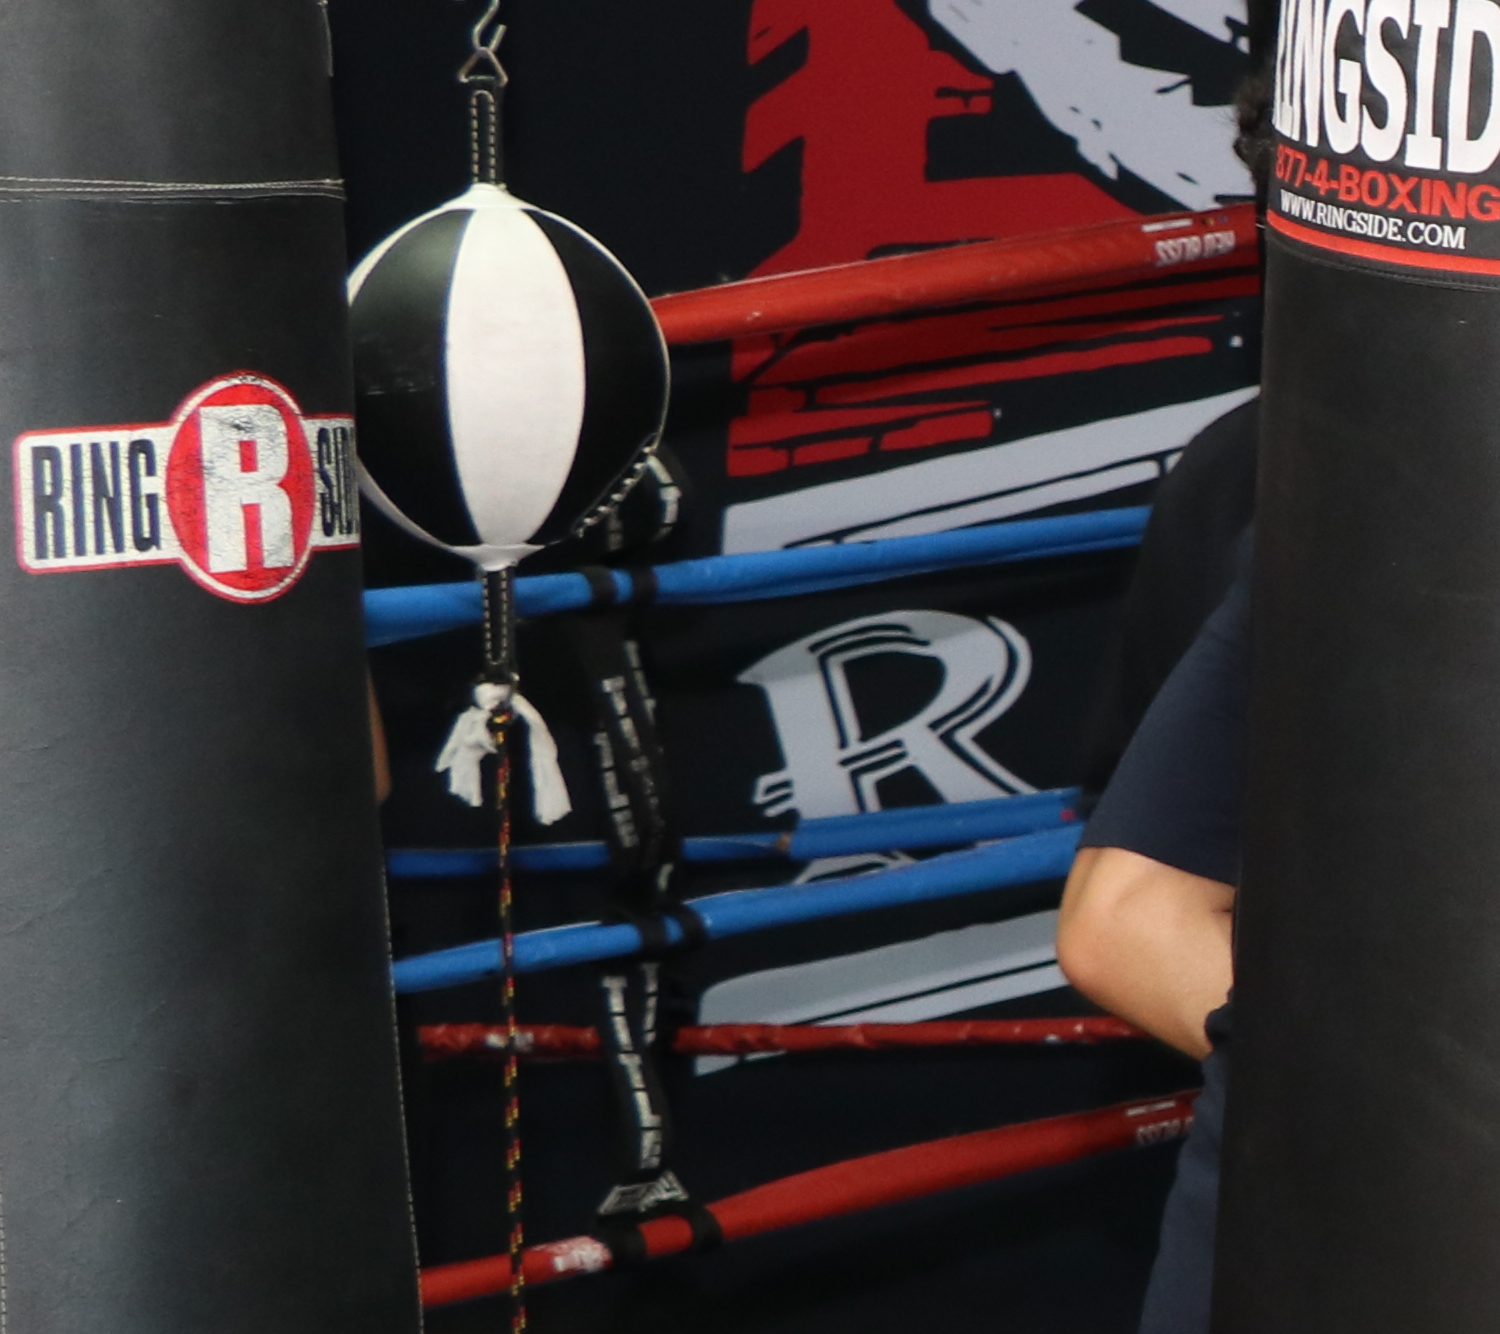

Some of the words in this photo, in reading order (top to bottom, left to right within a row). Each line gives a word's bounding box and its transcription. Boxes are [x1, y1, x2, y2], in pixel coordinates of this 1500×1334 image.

[1279, 187, 1466, 250] WWW.RINGSIDE.COM
[31, 438, 162, 560] RING
[199, 404, 295, 573] R
